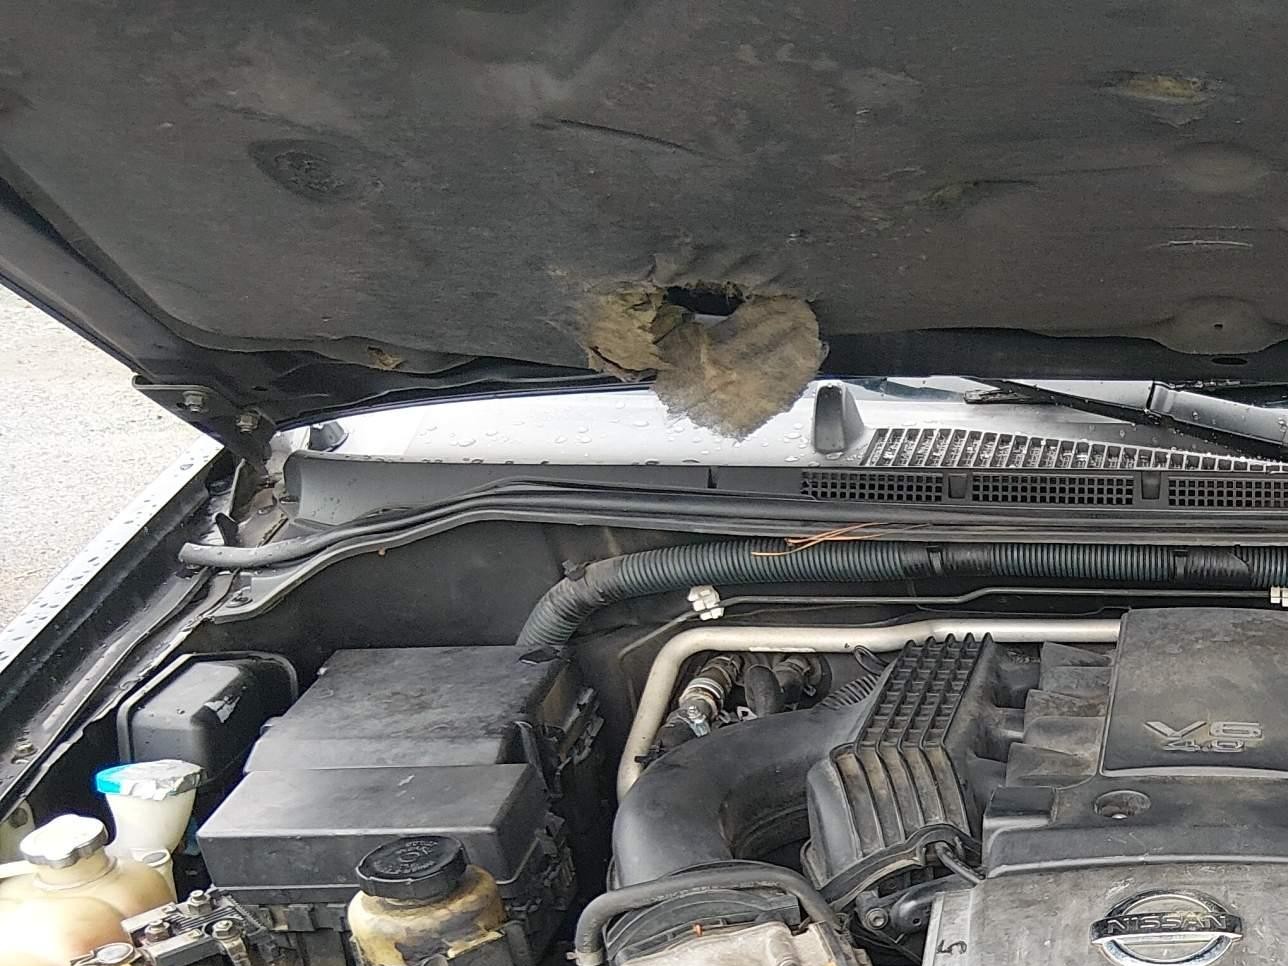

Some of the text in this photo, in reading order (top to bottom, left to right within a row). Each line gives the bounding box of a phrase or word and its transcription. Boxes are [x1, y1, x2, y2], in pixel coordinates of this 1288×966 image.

[1143, 720, 1264, 741] V6
[1162, 739, 1246, 753] 4.0
[1107, 914, 1227, 935] NISSAN
